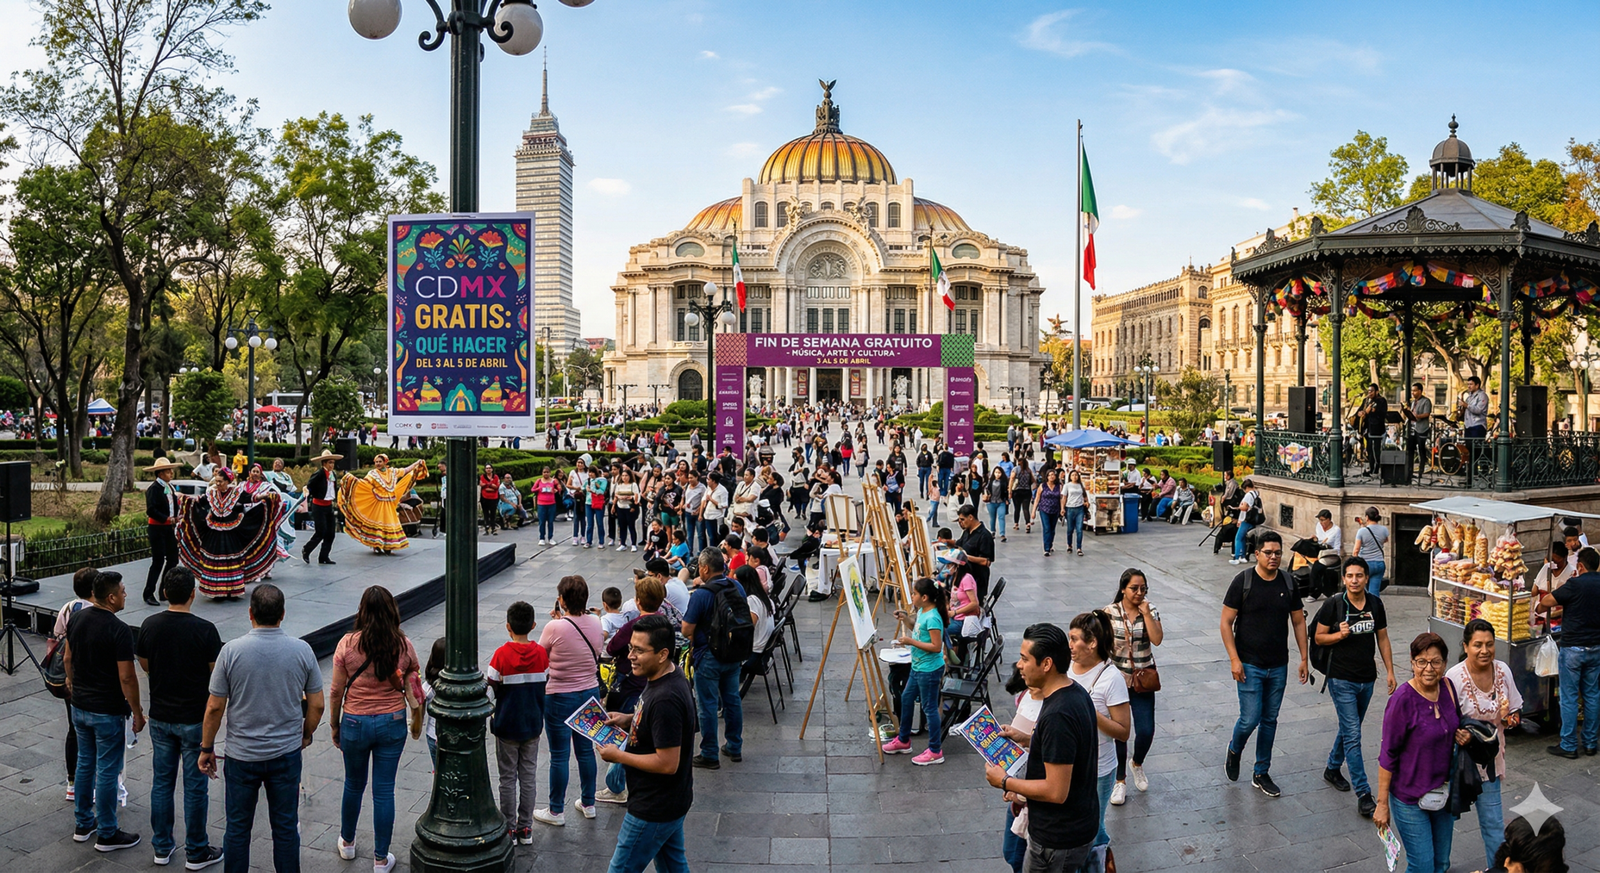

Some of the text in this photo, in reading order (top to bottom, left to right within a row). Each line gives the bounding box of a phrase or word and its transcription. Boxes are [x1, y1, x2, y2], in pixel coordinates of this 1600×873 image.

[415, 275, 507, 299] CDMX
[415, 303, 512, 330] GRATIS:
[415, 333, 507, 355] QUÉ HACER
[755, 337, 933, 349] FIN DE SEMANA GRATUITO
[791, 348, 825, 358] MÚSICA,
[826, 349, 848, 357] ARTE
[850, 349, 856, 357] Y
[857, 349, 895, 357] CULTURA
[416, 358, 508, 368] DEL 3 AL 5 DE ABRIL
[816, 357, 872, 365] 3 AL 5 DE ABRIL
